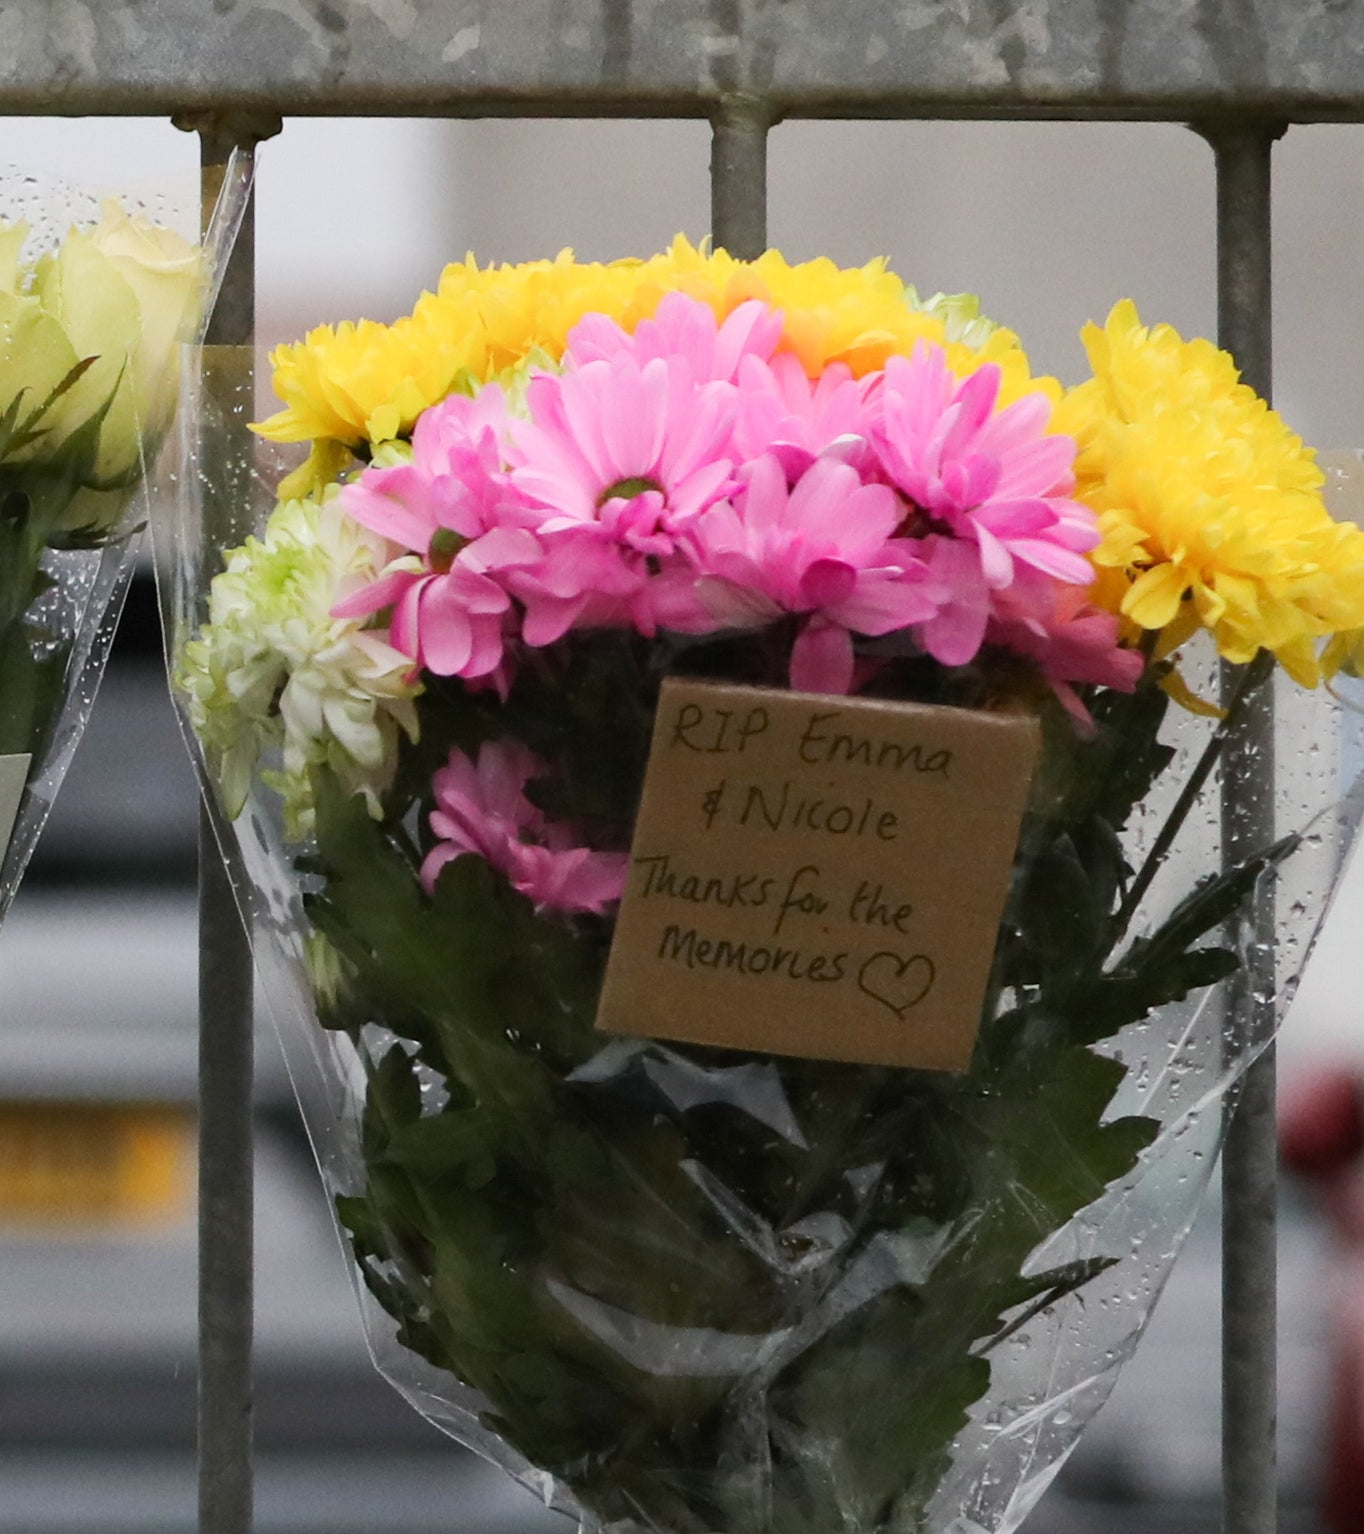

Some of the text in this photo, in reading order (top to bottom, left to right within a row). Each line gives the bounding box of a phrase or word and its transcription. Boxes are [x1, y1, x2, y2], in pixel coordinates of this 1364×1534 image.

[672, 703, 954, 779] RIP Emma
[701, 779, 898, 841] & Nicole
[849, 879, 913, 934] the
